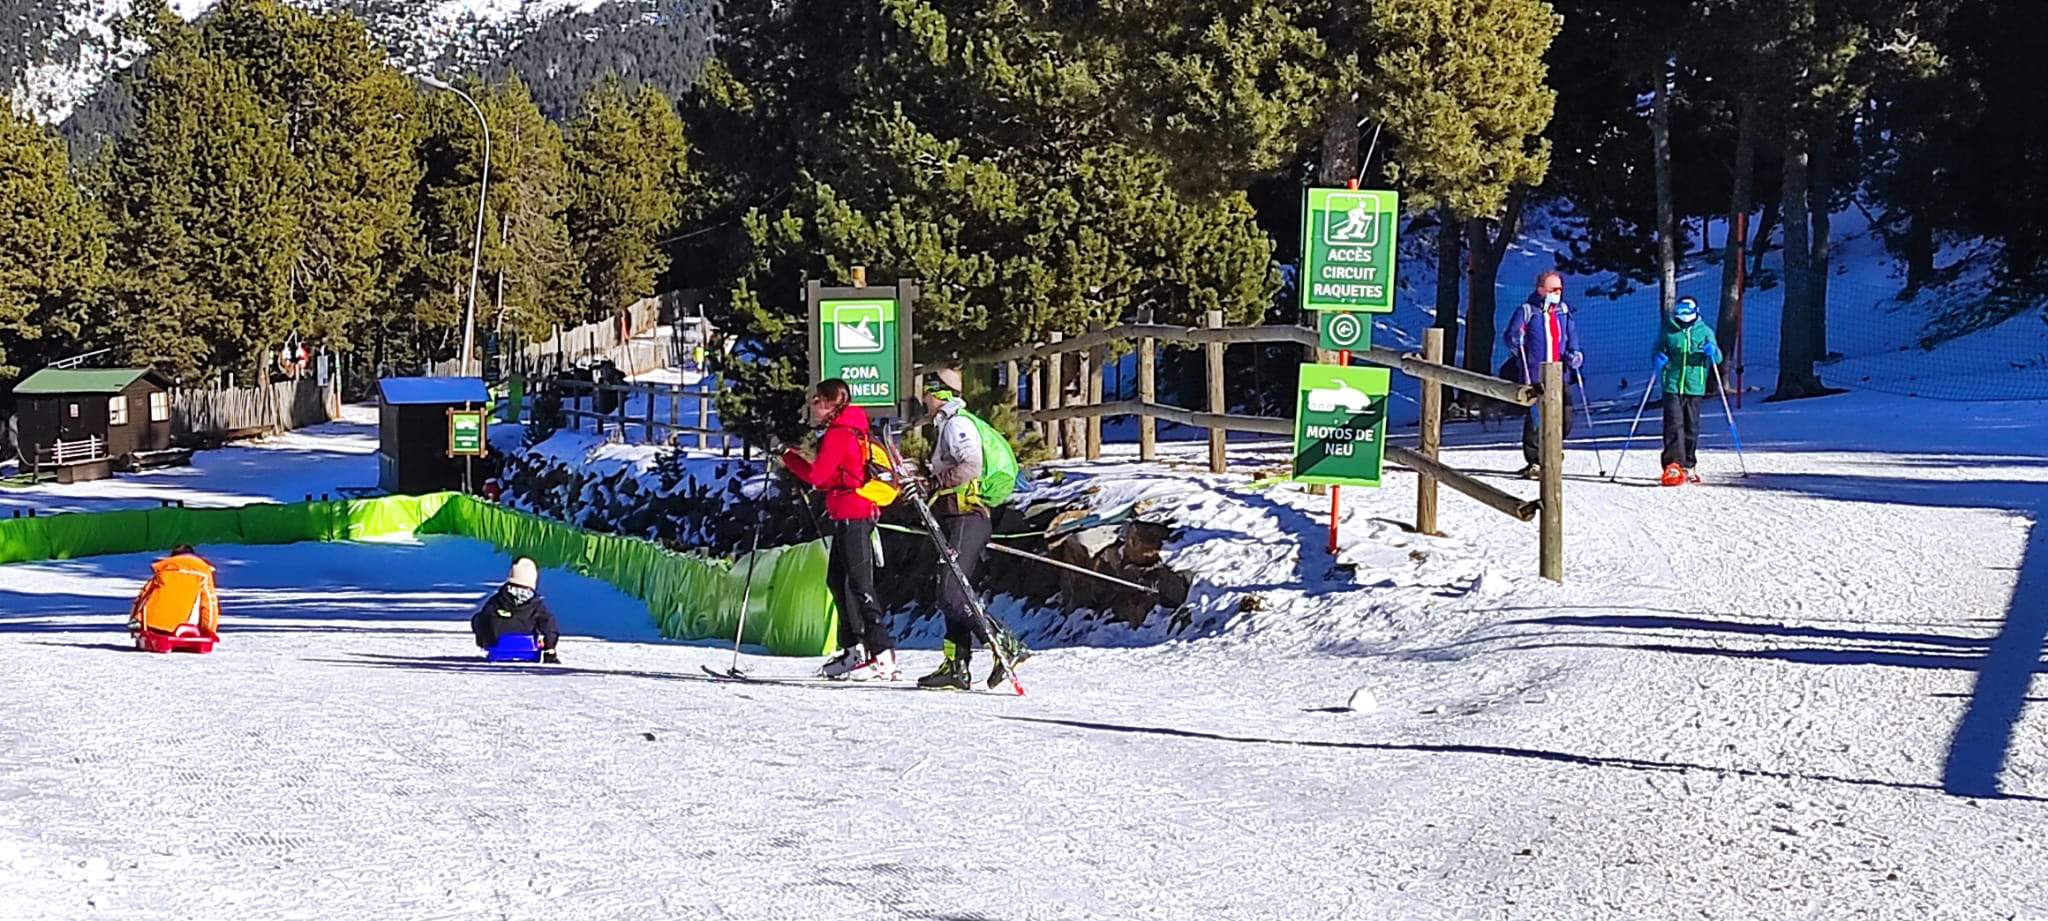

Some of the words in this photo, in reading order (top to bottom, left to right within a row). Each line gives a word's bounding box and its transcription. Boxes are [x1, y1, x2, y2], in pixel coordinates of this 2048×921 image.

[1328, 247, 1372, 262] ACCÈS
[1322, 266, 1376, 280] CIRCUIT
[1313, 283, 1383, 298] RAQUETES
[841, 366, 879, 379] ZONA
[849, 382, 889, 396] INEUS
[1306, 425, 1353, 440] MOTOS
[1355, 428, 1374, 442] DE
[1325, 442, 1354, 456] NEU
